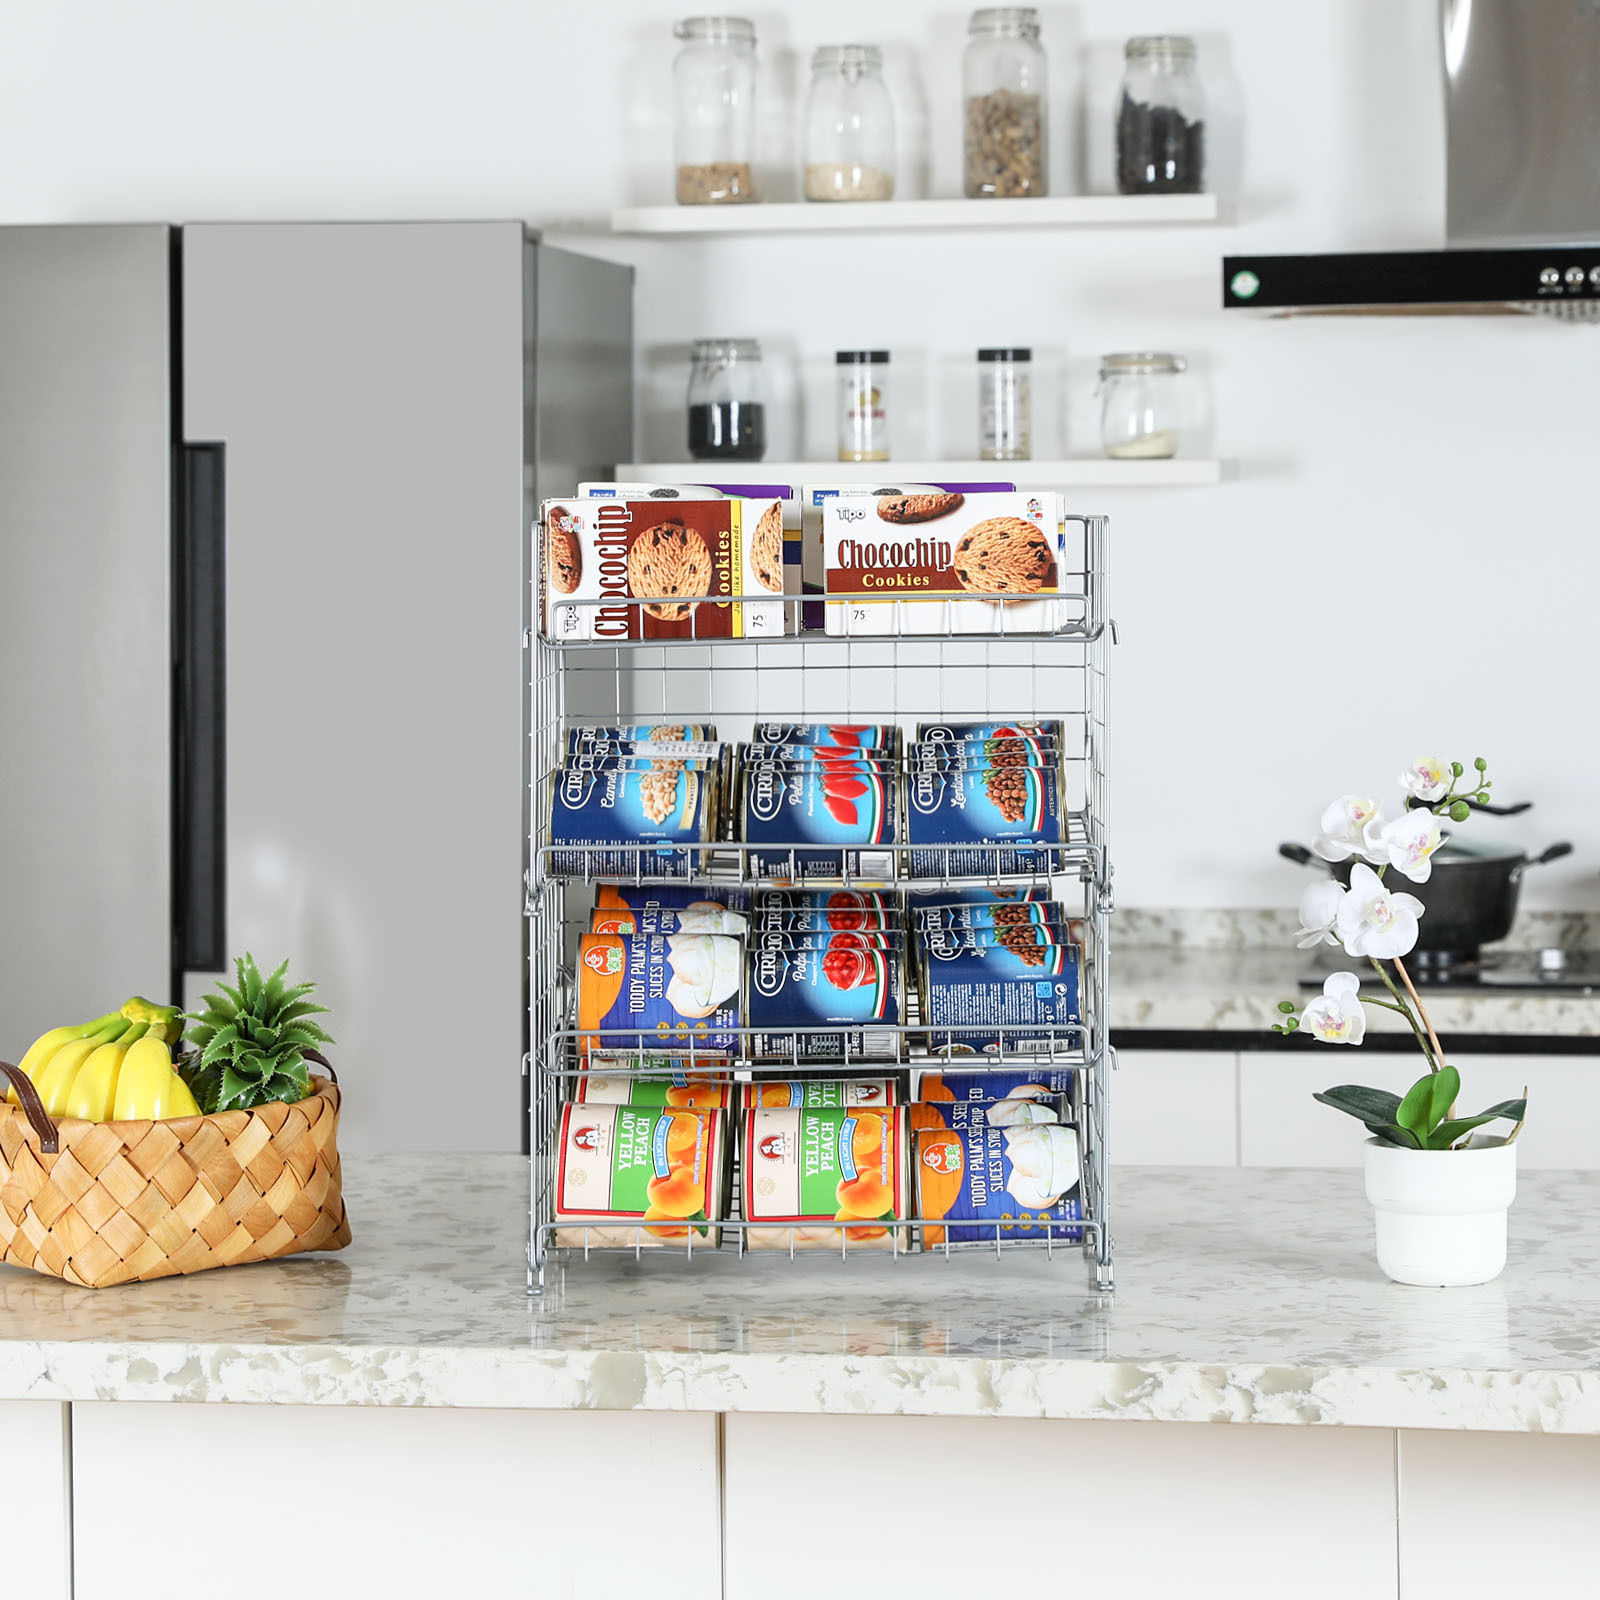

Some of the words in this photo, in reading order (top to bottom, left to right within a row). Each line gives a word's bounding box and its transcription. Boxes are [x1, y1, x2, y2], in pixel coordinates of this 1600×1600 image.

[836, 507, 865, 522] Tipo
[732, 524, 740, 572] homemade
[838, 538, 952, 571] Chocochip
[862, 573, 930, 587] Cookies
[753, 615, 763, 627] 75
[853, 610, 865, 620] 75
[651, 955, 663, 963] IN
[630, 978, 645, 1013] TODDY
[649, 967, 663, 998] SLICES
[618, 1111, 636, 1171] YELLOW
[634, 1117, 651, 1166] PEACH
[805, 1115, 819, 1177] YELLOW
[821, 1122, 834, 1171] PEACH
[989, 1150, 1002, 1158] IN
[969, 1174, 987, 1207] TODDY
[988, 1161, 1004, 1192] SLICES
